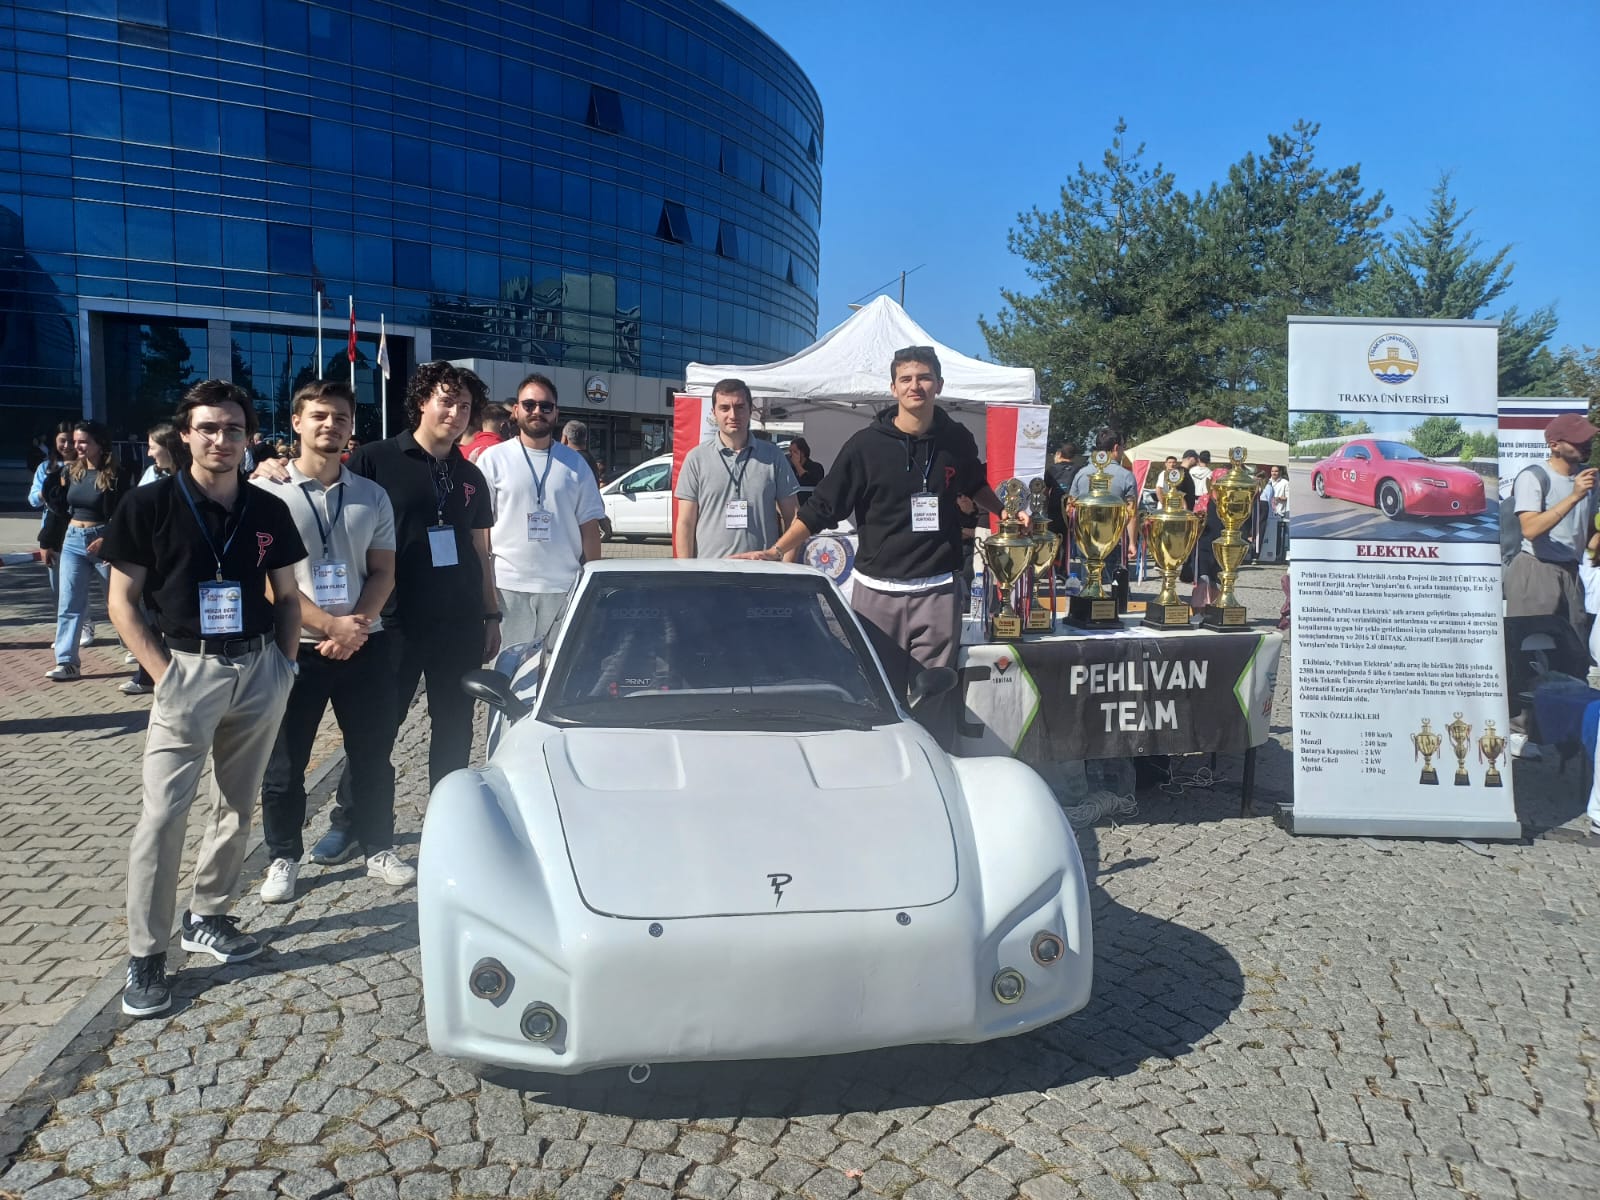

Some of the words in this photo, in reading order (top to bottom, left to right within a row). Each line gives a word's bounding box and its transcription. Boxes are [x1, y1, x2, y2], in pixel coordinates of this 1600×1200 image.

[1338, 394, 1378, 403] TRAKYA
[1381, 393, 1449, 404] ÜNİVERSİTESİ
[1357, 545, 1439, 558] ELEKTRAK
[1070, 652, 1208, 695] PEHLİVAN
[1101, 699, 1178, 732] TEAM
[1330, 711, 1380, 720] ÖZELLİKLERİ
